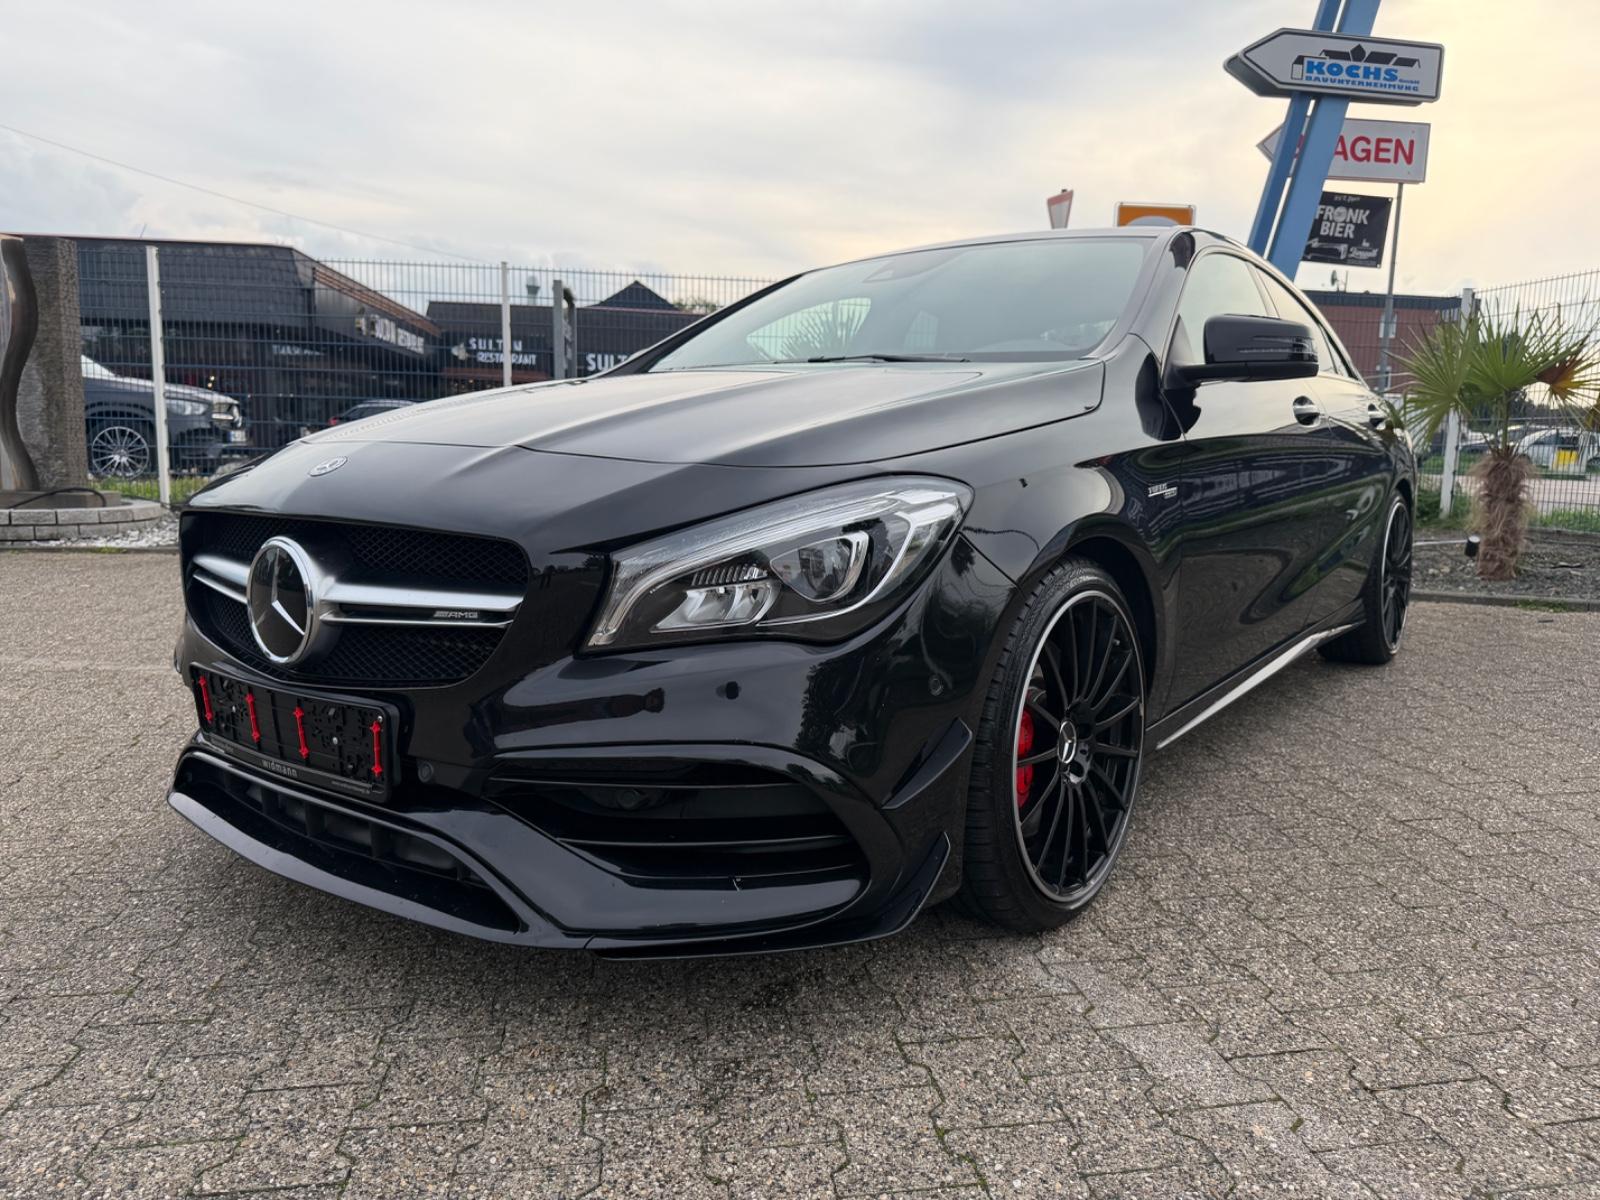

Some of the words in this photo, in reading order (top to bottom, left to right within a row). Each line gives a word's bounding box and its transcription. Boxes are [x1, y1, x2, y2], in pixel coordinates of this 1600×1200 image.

[1305, 60, 1399, 82] KOCHS
[1305, 75, 1419, 92] BAUUNTERNEHMUNG
[1320, 221, 1355, 239] BIER
[468, 337, 523, 351] SULTN
[476, 351, 536, 366] RESTARANT
